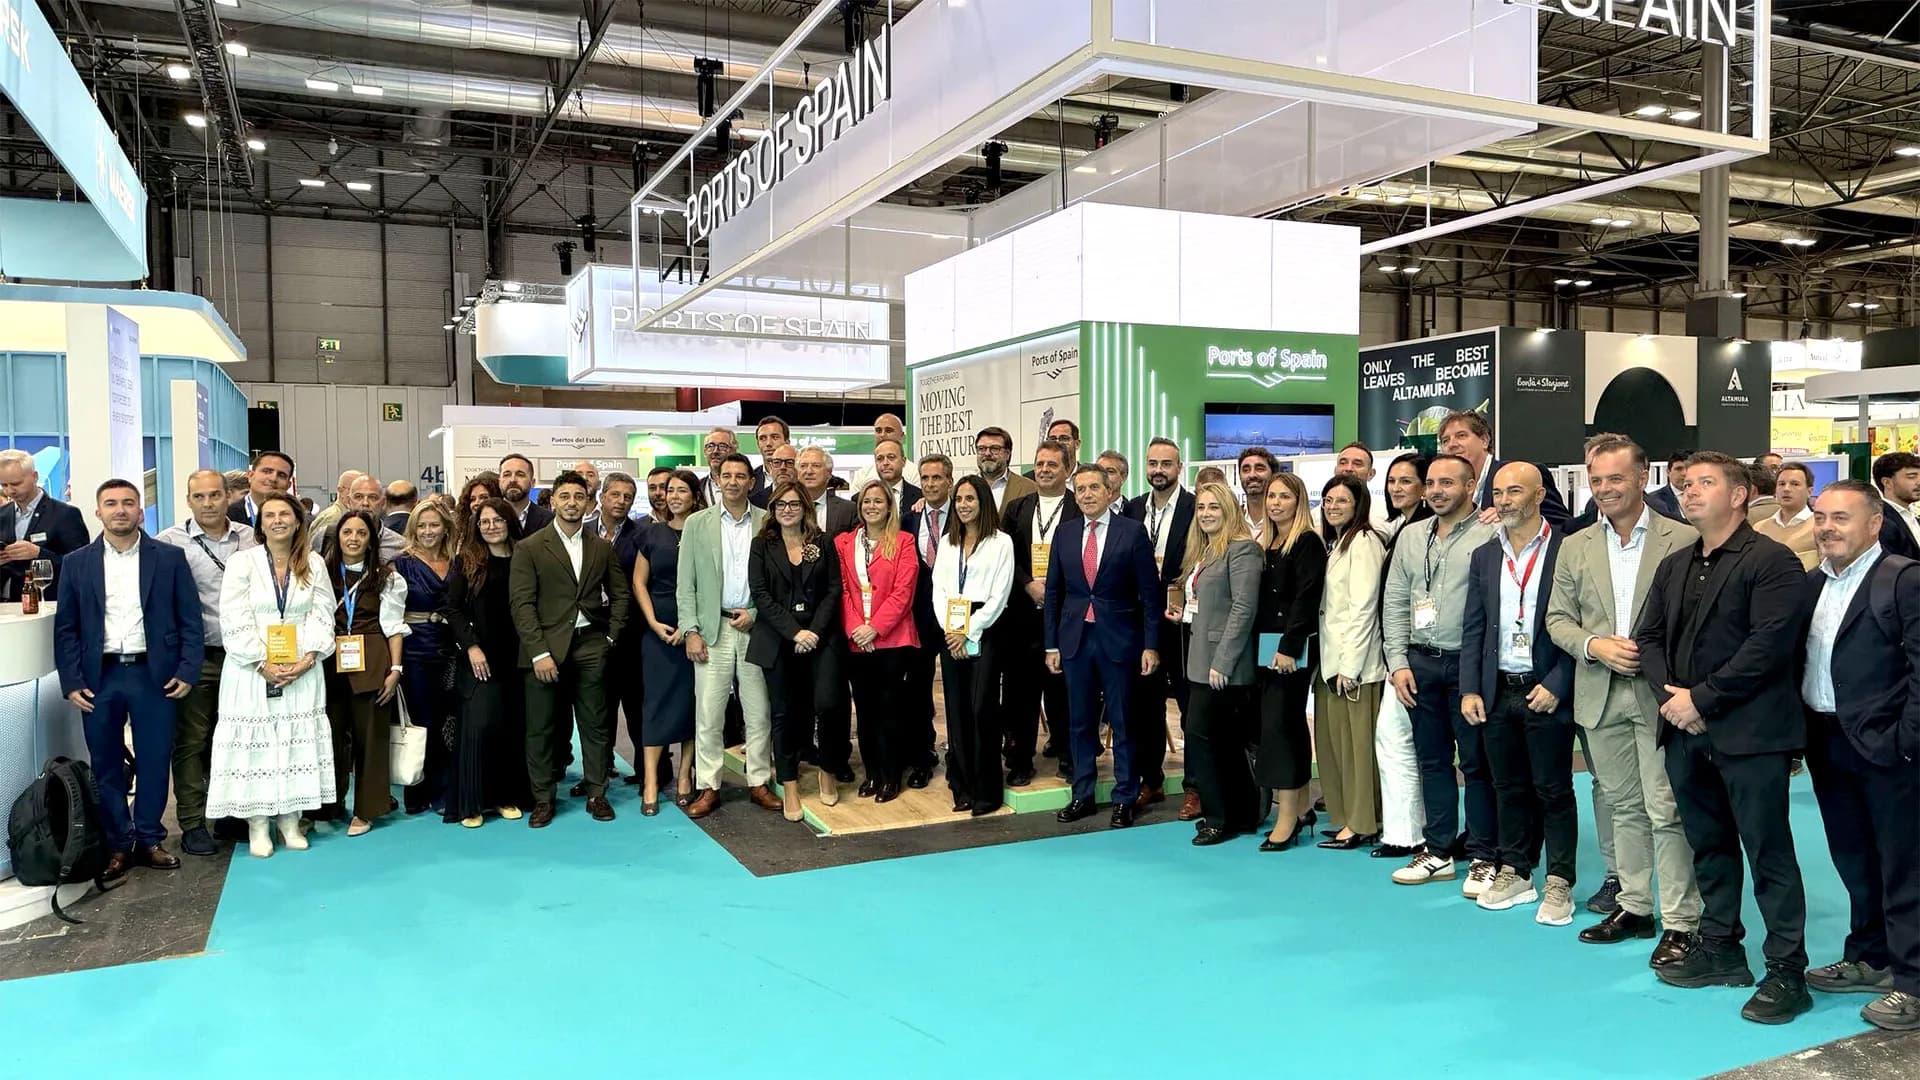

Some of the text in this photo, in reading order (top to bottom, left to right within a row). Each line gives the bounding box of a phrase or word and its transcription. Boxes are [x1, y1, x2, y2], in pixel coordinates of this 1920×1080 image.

[686, 23, 891, 246] PORTS OF SPAIN
[735, 313, 777, 334] OF
[785, 316, 872, 340] SPAIN
[1031, 347, 1079, 367] Ports of Spain
[1208, 346, 1328, 372] Ports of Spain
[1363, 345, 1490, 376] ONLY THE BEST
[1363, 361, 1490, 390] LEAVES BECOME
[920, 386, 966, 413] MOVING
[1393, 381, 1456, 401] ALTAMURA
[920, 410, 974, 437] THE BEST
[920, 435, 977, 458] OF NATUR
[421, 465, 444, 483] 4b
[596, 460, 623, 471] Spain
